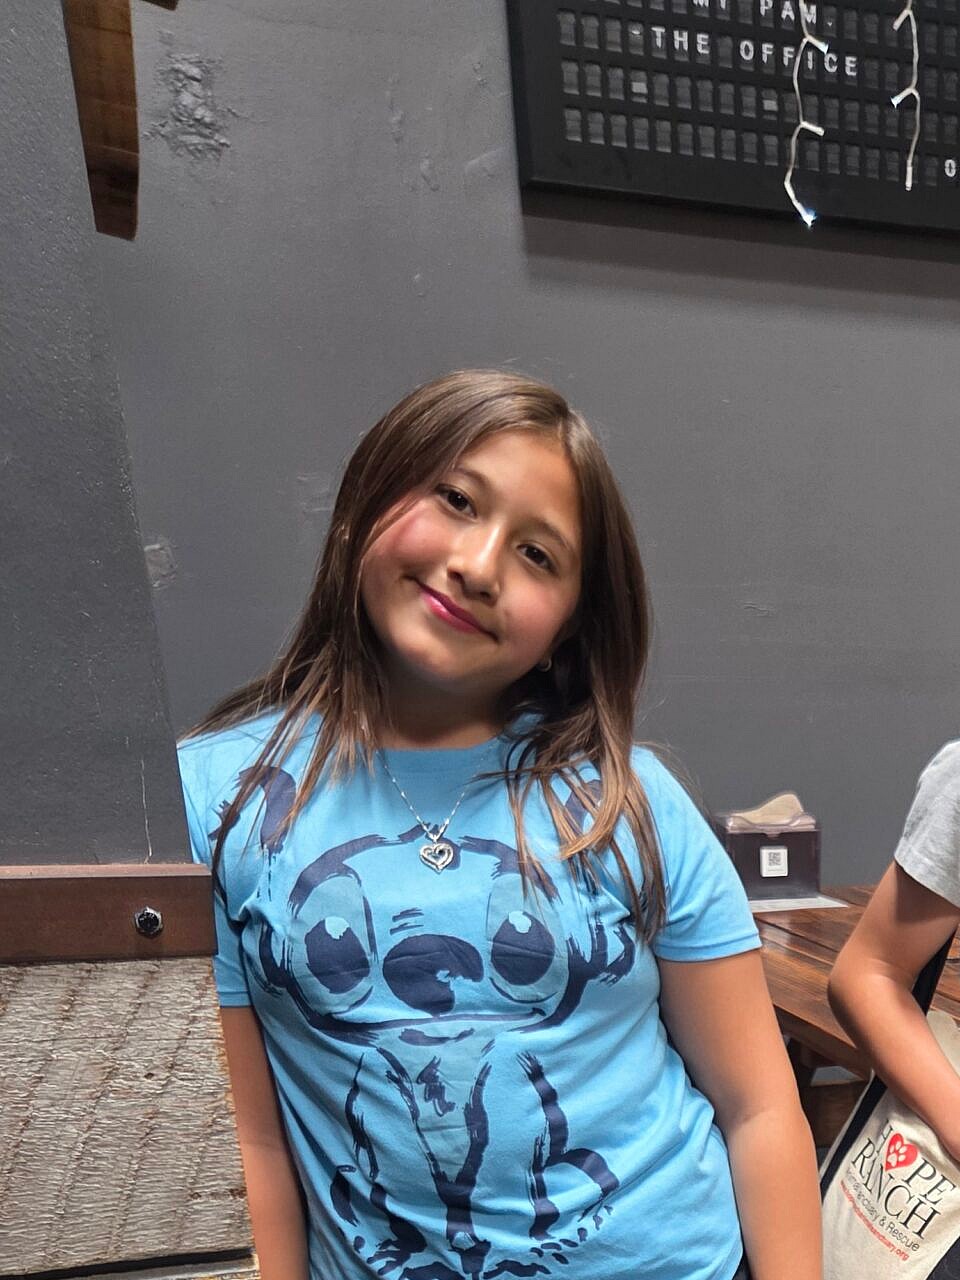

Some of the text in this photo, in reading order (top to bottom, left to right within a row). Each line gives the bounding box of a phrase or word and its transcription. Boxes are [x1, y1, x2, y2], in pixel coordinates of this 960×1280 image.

[740, 40, 858, 76] OFFICE
[878, 1216, 887, 1227] &
[885, 1221, 921, 1252] Rescue
